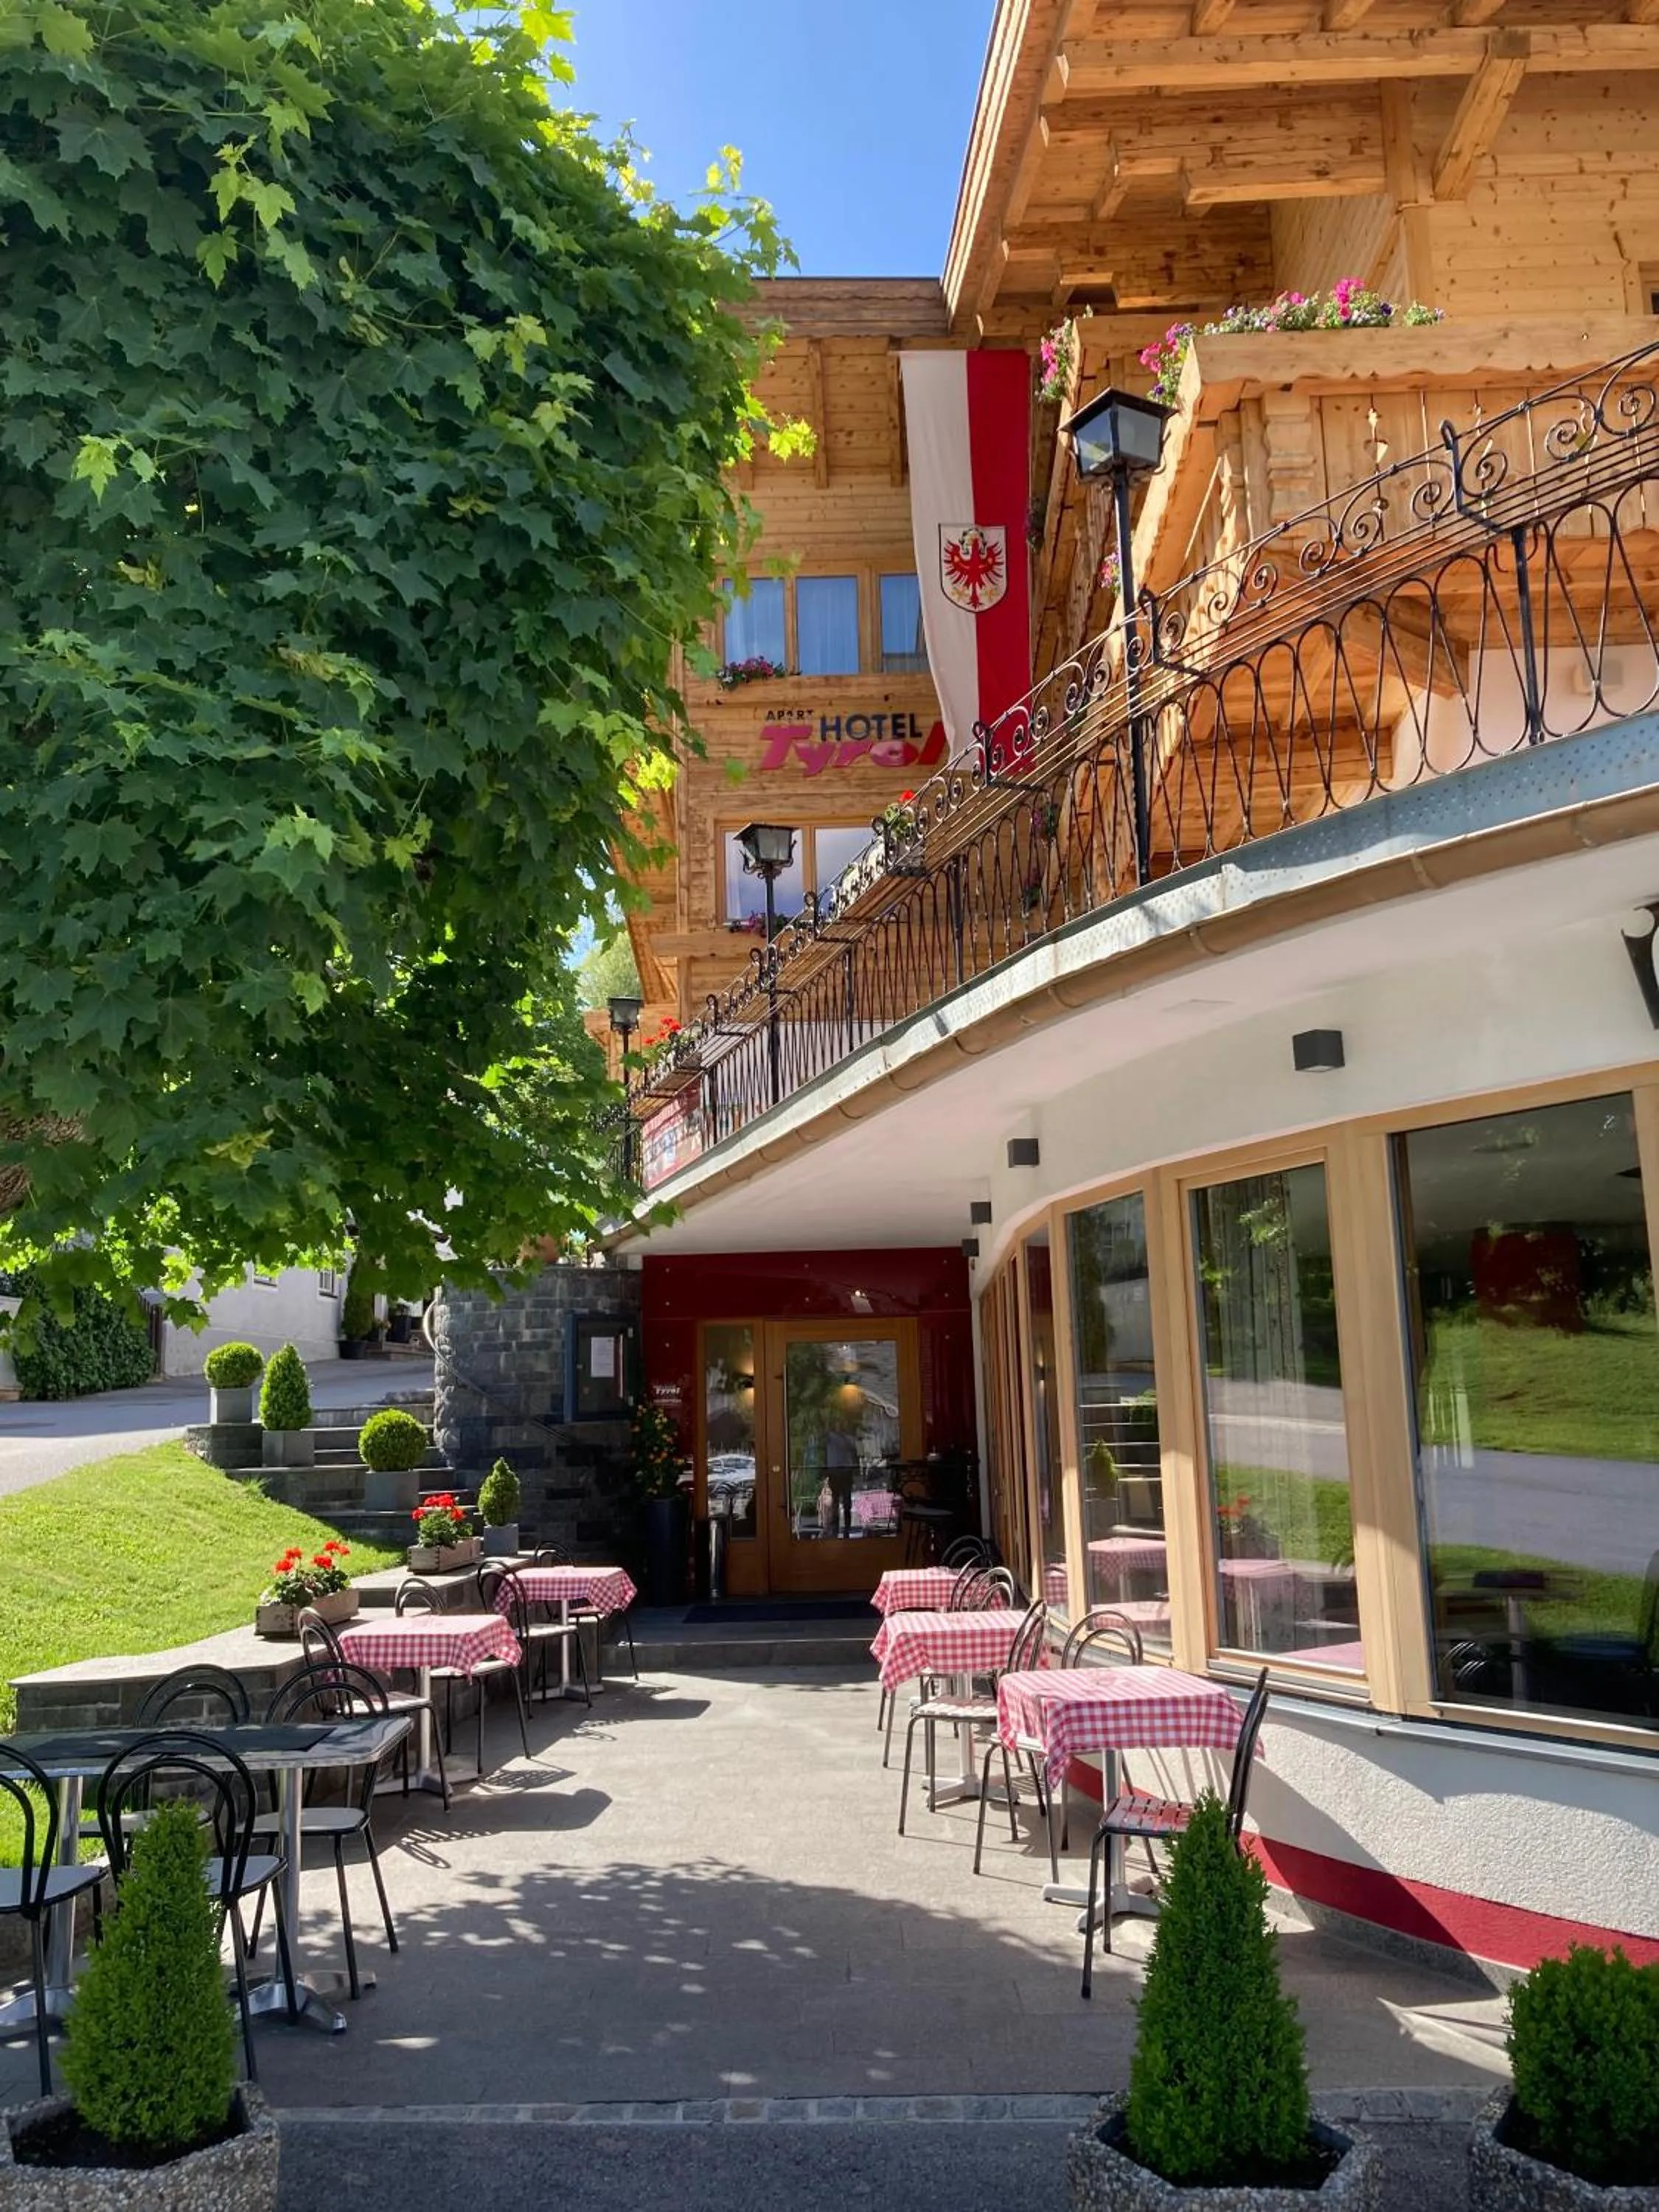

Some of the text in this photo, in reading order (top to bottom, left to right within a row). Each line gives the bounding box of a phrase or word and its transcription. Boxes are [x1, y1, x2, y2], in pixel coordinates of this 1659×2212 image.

[766, 709, 814, 720] APART
[820, 713, 922, 742] HOTEL
[759, 720, 947, 778] Tyrol
